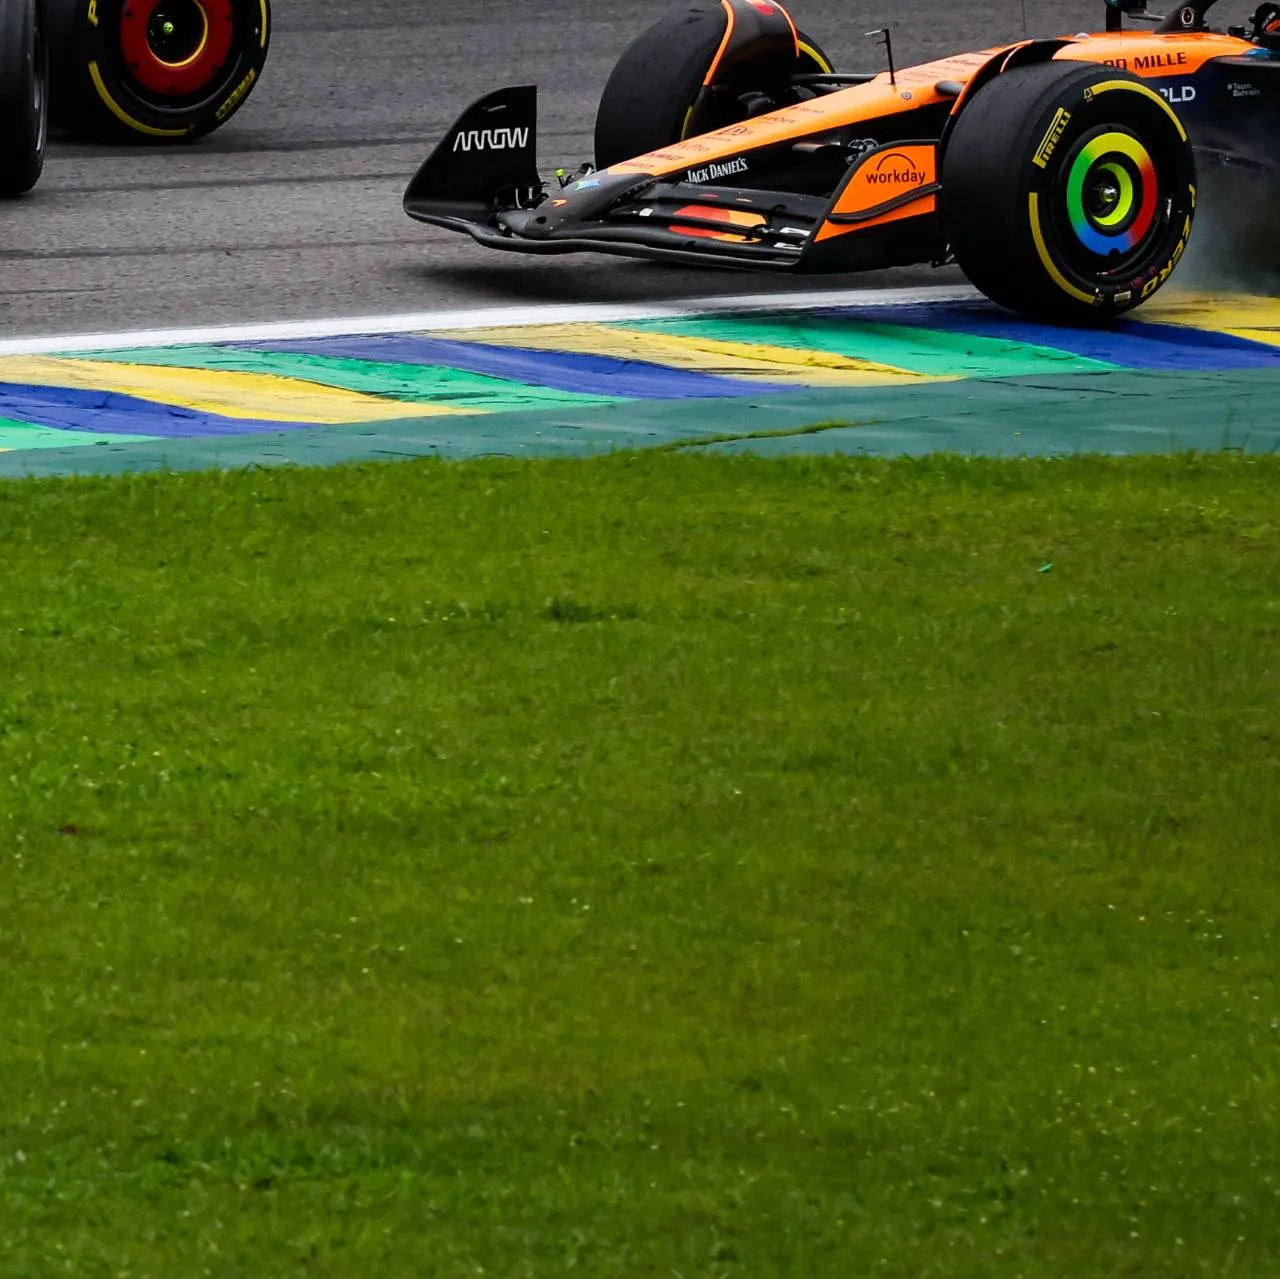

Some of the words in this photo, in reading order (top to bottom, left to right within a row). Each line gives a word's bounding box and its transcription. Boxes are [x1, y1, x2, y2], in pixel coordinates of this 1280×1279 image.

[1134, 51, 1188, 70] MILLE
[1031, 106, 1072, 170] PIRELLI
[685, 169, 709, 185] JACK
[866, 168, 926, 186] workday
